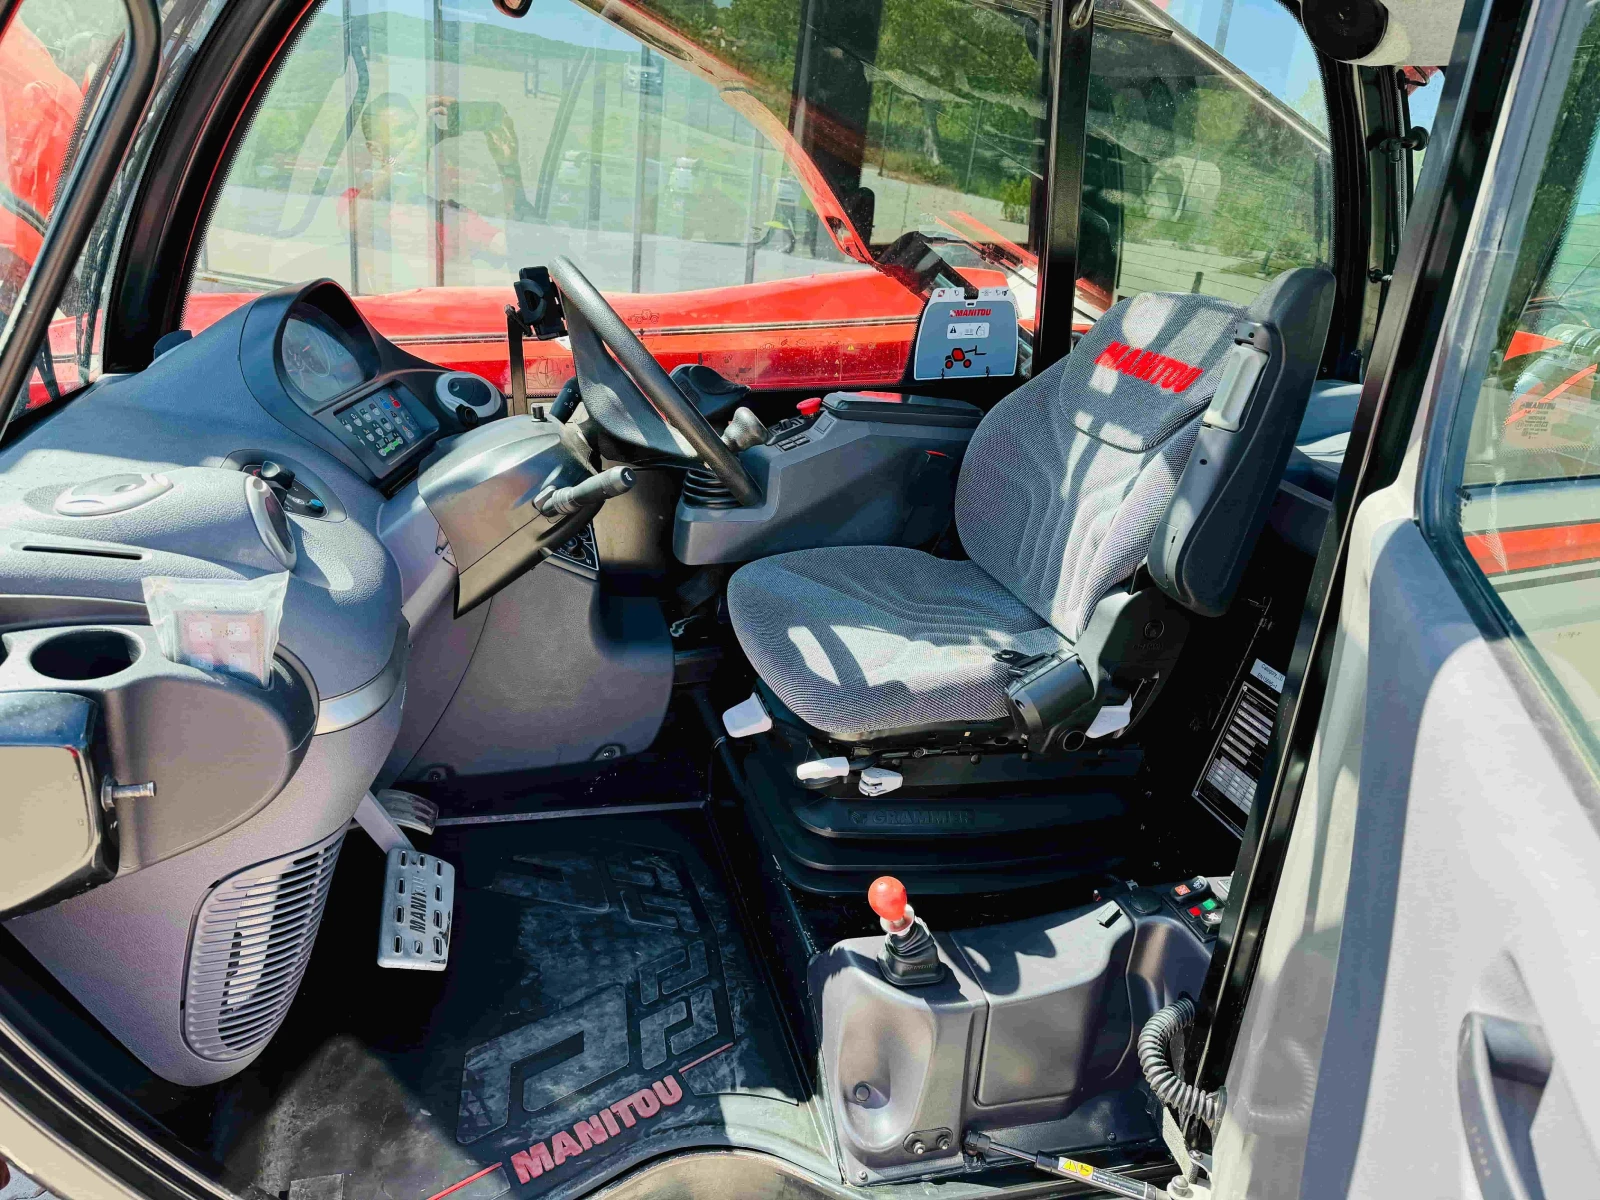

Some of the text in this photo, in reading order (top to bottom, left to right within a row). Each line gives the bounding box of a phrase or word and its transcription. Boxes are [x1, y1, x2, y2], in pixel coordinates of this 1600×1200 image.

[955, 309, 991, 317] MANITOU
[1094, 341, 1204, 393] MANITOU
[510, 1074, 683, 1185] MANITOU
